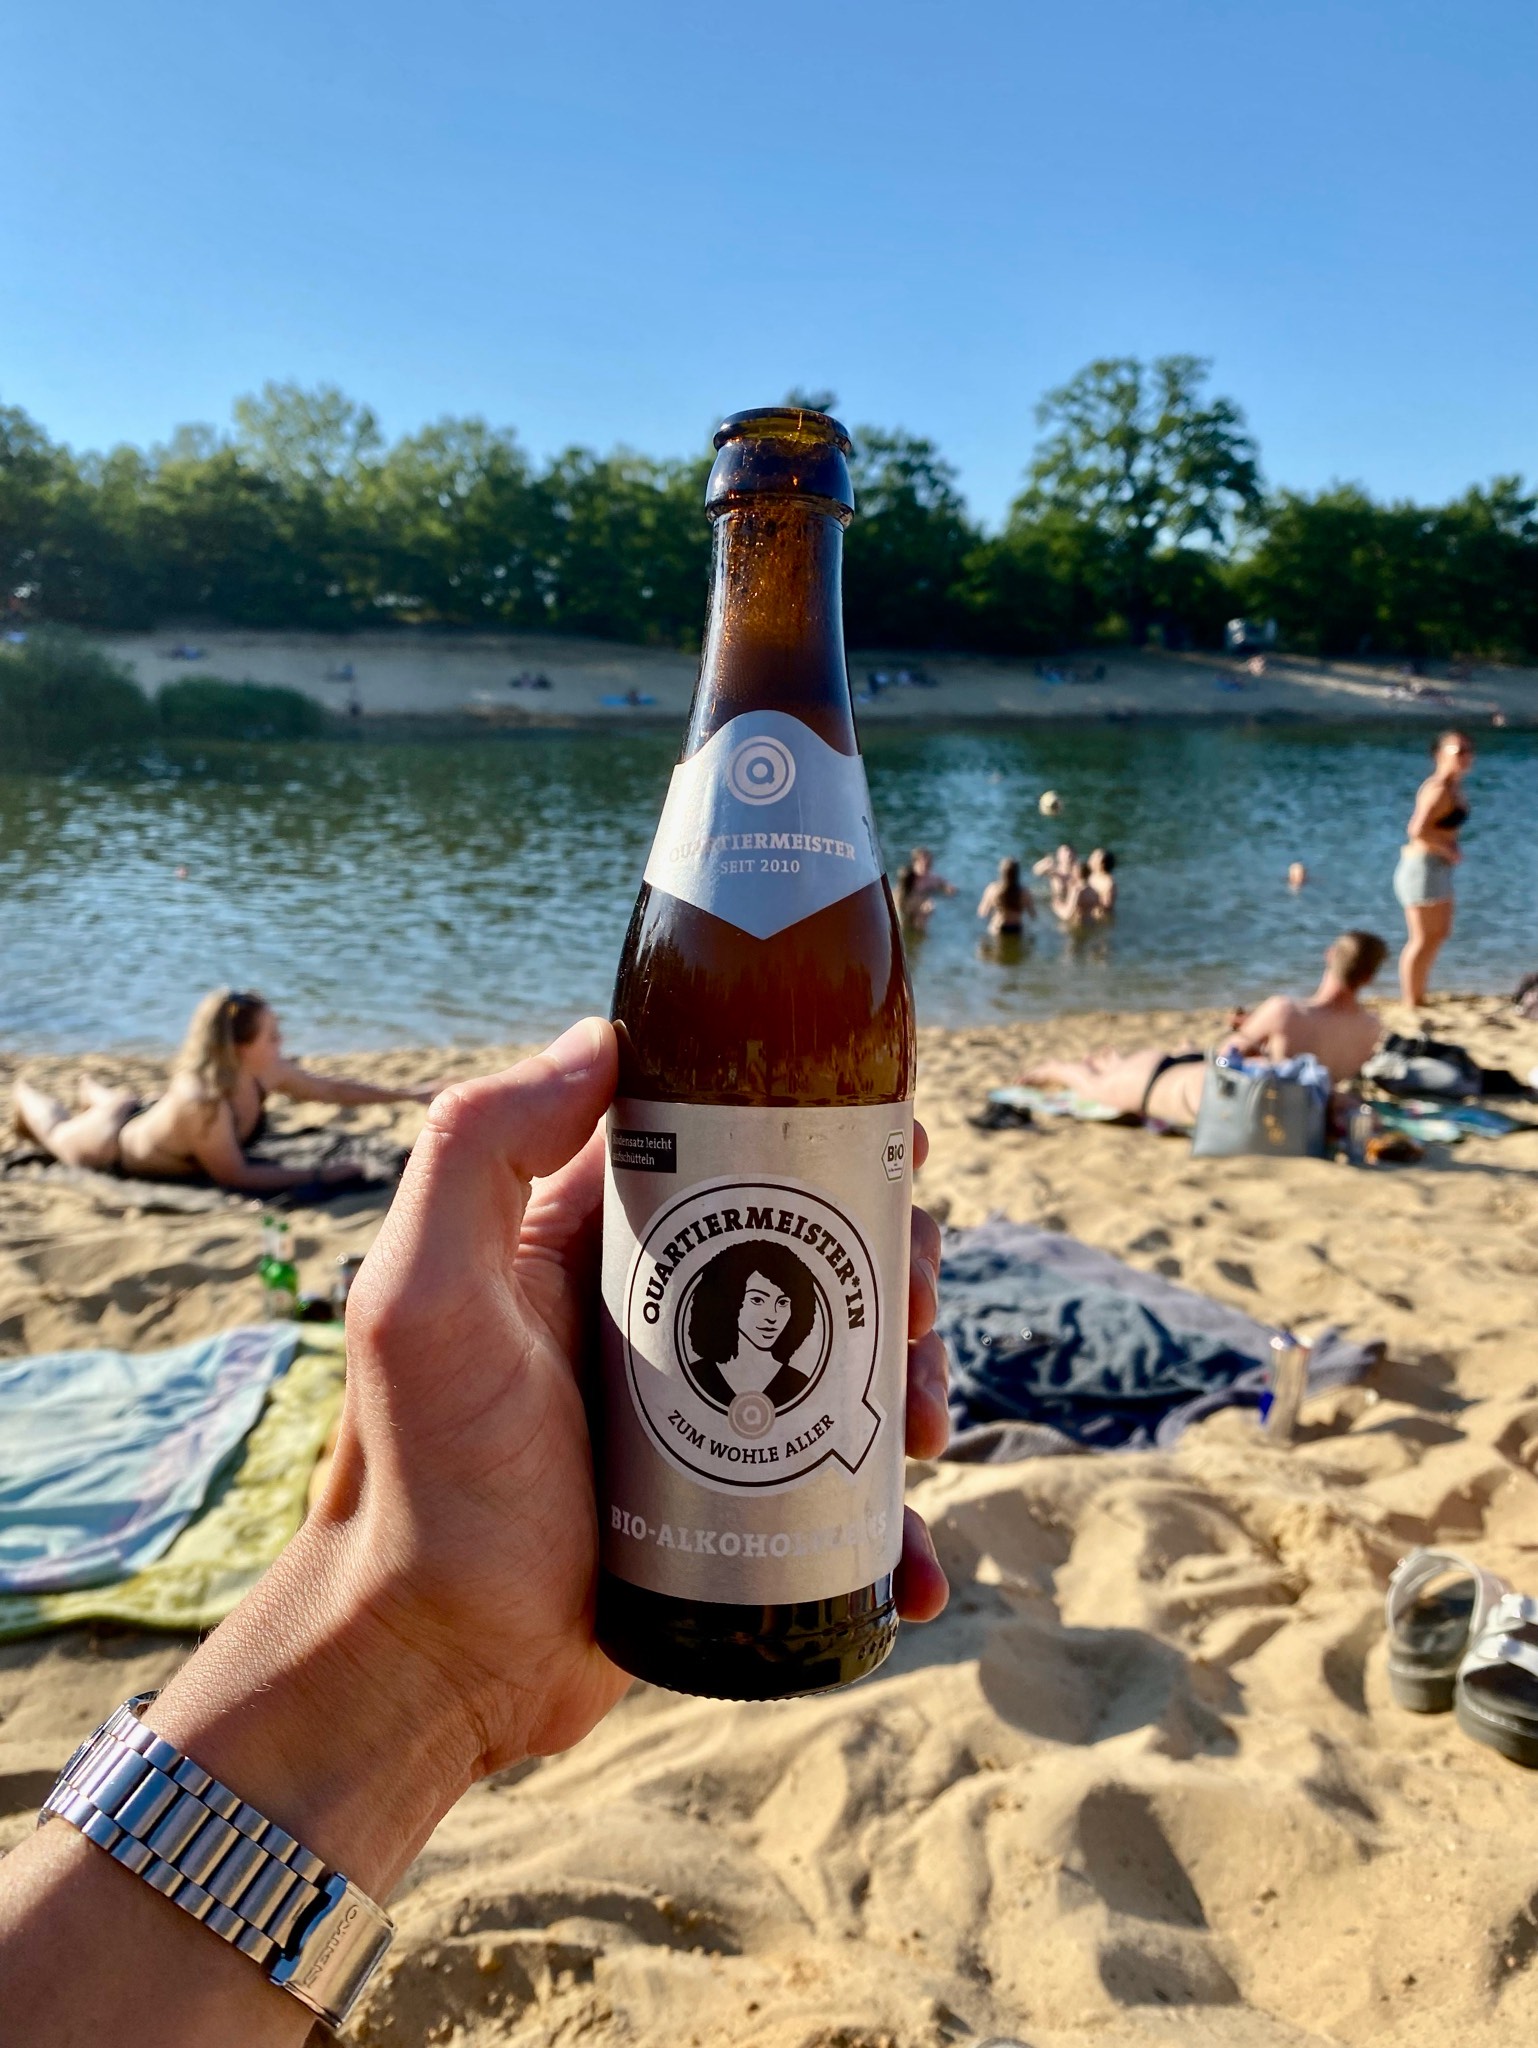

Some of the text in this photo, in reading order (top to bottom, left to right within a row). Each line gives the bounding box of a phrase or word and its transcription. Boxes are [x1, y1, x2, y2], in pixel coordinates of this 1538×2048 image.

[720, 859, 800, 875] SEIT 2010
[645, 1136, 672, 1150] leicht
[667, 1409, 835, 1464] ZUM WOHLE ALLER
[303, 1904, 359, 1989] SEIKO
